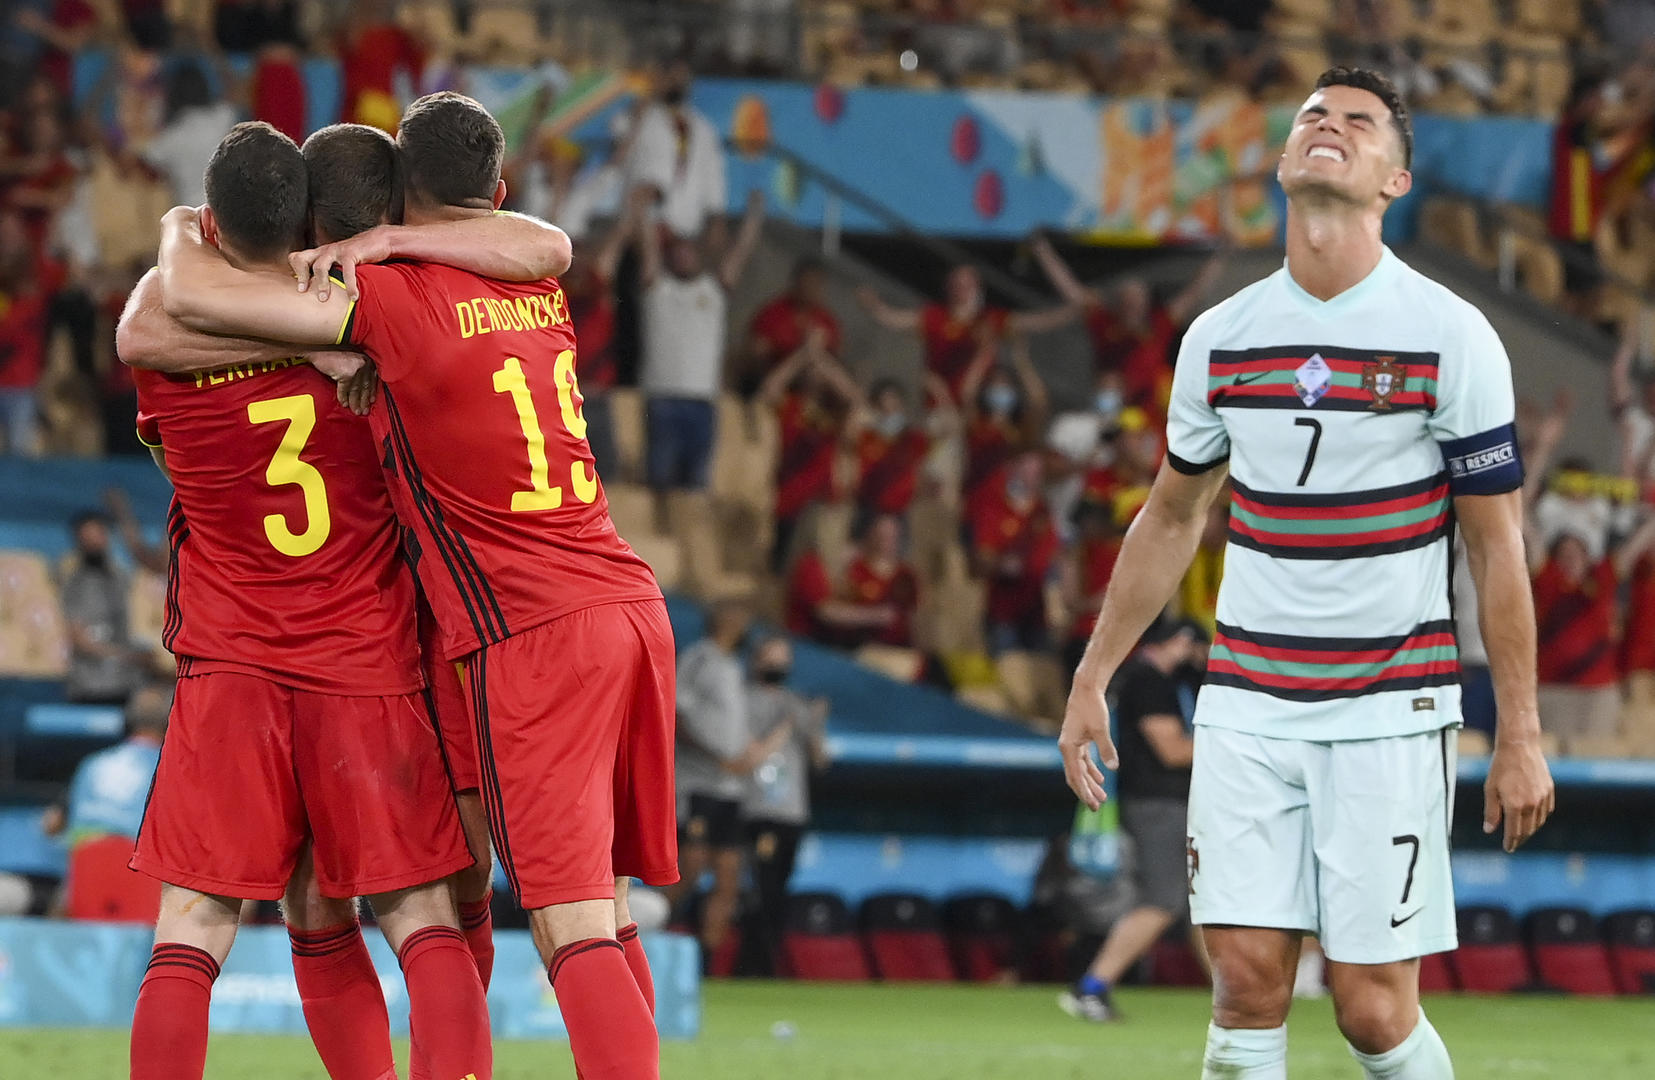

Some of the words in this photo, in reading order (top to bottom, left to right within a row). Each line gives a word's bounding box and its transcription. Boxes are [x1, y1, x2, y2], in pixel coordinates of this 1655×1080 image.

[492, 349, 597, 512] 19
[1294, 417, 1321, 486] 7
[1465, 446, 1514, 470] RESPECT
[247, 394, 331, 557] 3
[1392, 834, 1419, 903] 7
